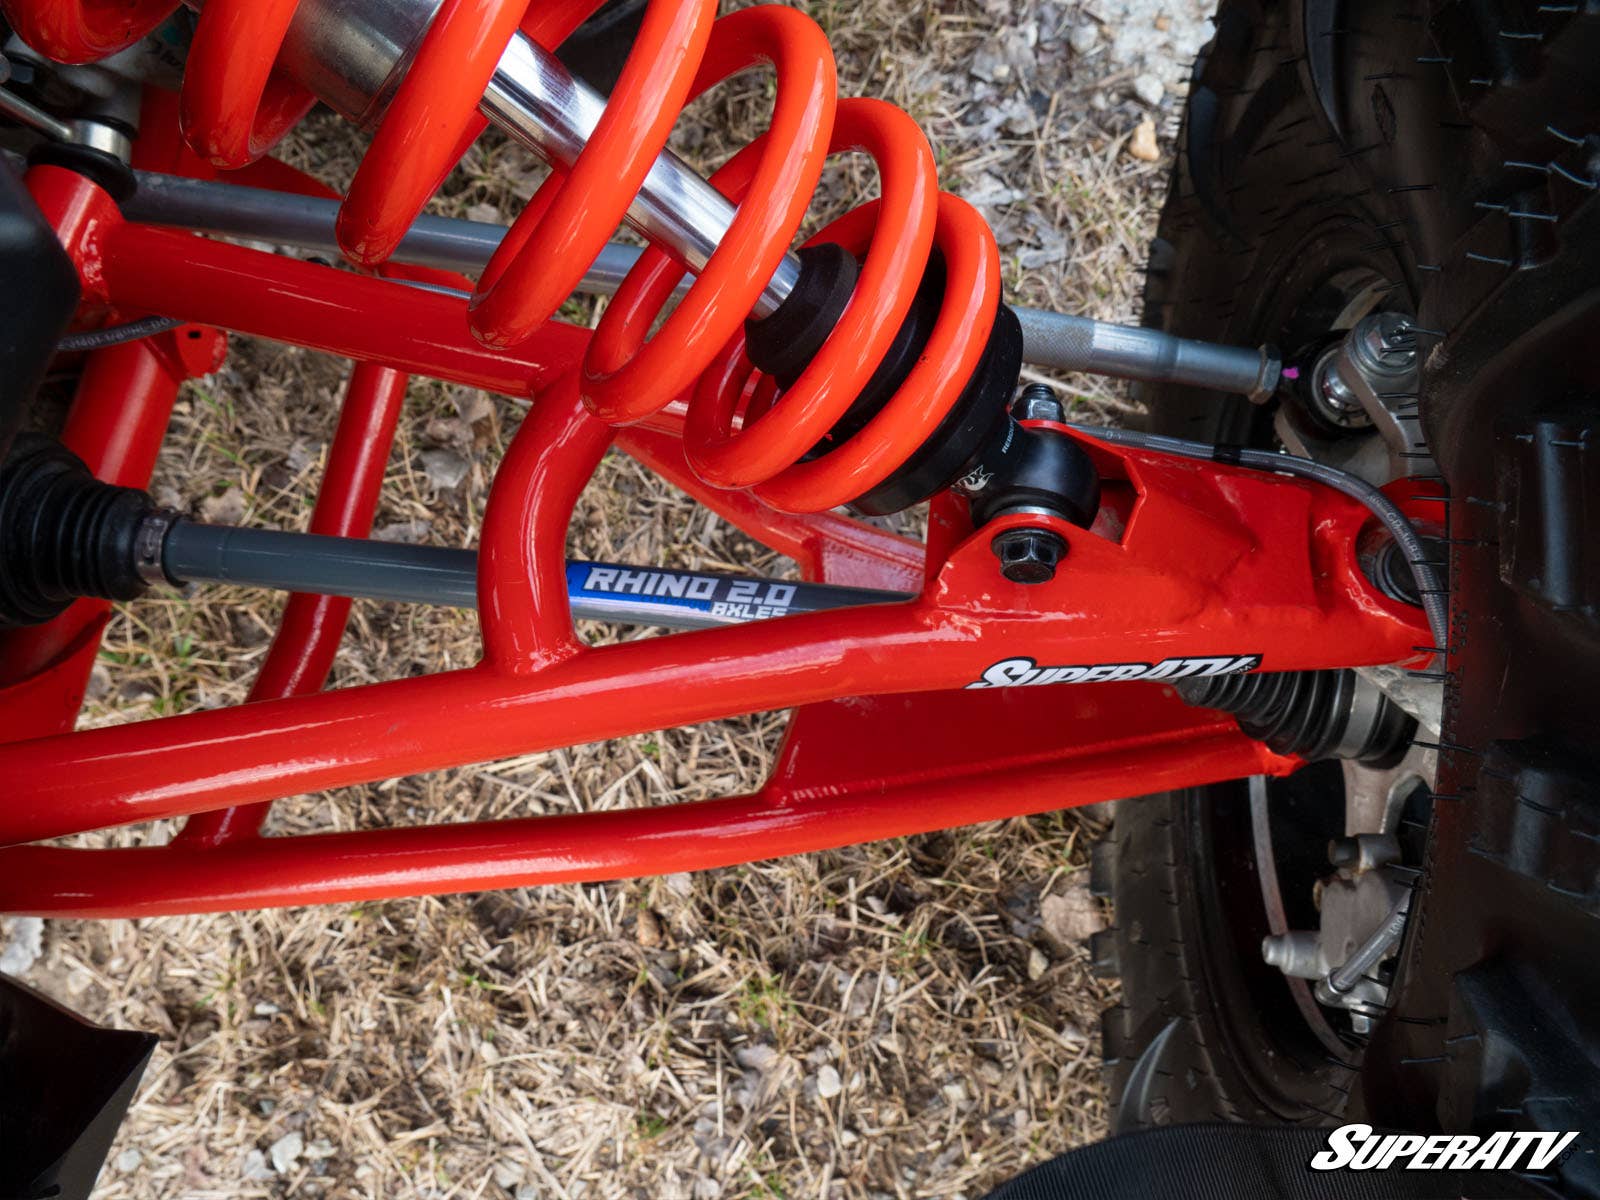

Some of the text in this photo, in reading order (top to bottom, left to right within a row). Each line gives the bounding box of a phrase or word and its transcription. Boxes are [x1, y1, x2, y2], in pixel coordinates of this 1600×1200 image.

[583, 567, 798, 607] RHINO 2.0
[964, 656, 1257, 689] SUPERATV
